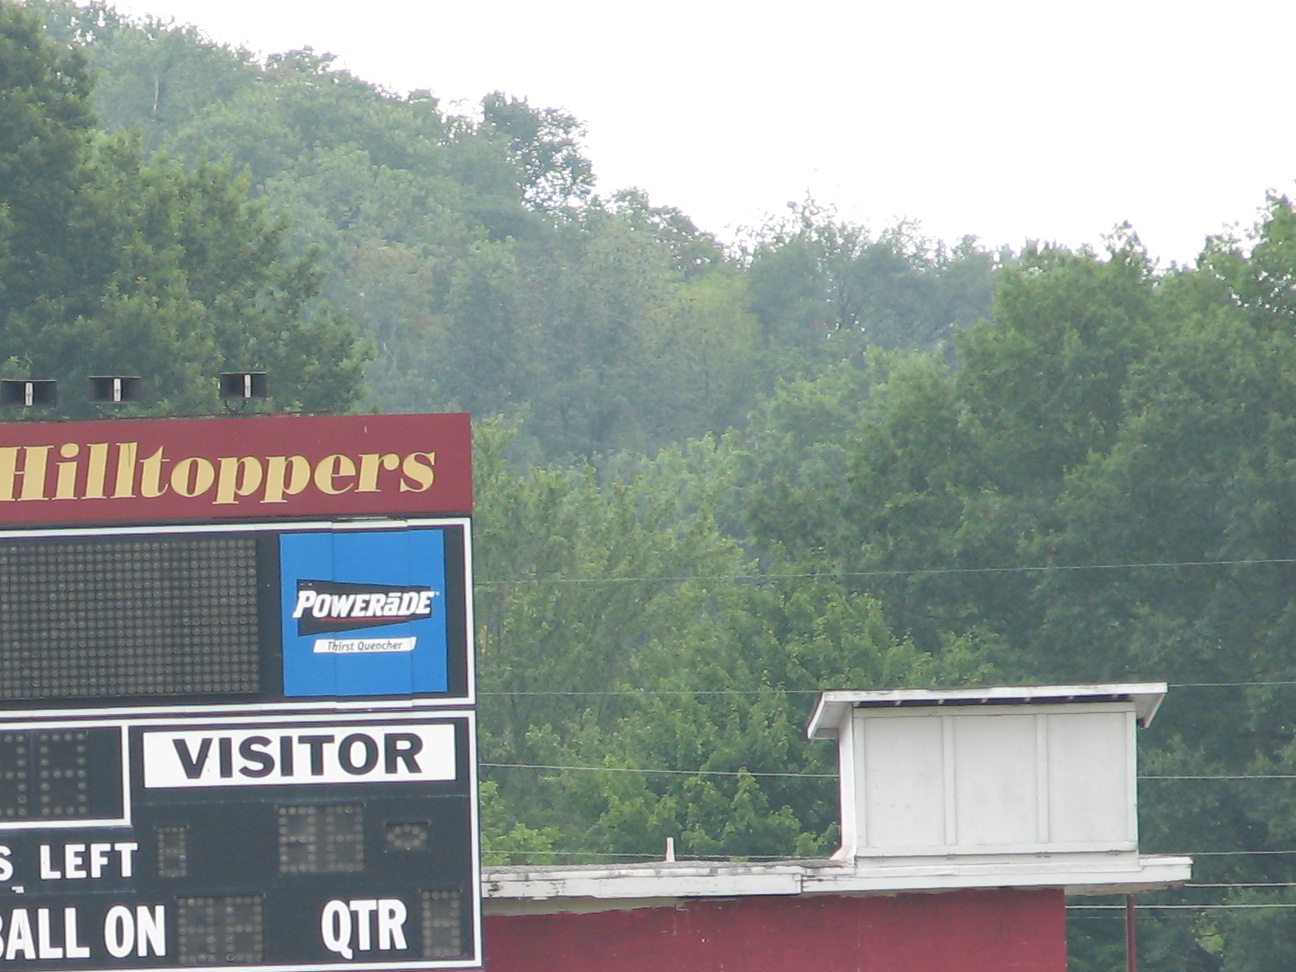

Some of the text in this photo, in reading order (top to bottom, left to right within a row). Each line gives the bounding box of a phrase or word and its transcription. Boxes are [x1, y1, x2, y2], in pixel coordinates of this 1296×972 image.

[328, 641, 403, 651] Thirst Quencher
[172, 732, 424, 779] VISITOR
[39, 842, 138, 880] LEFT
[103, 904, 166, 958] ON
[321, 898, 407, 960] QTR
